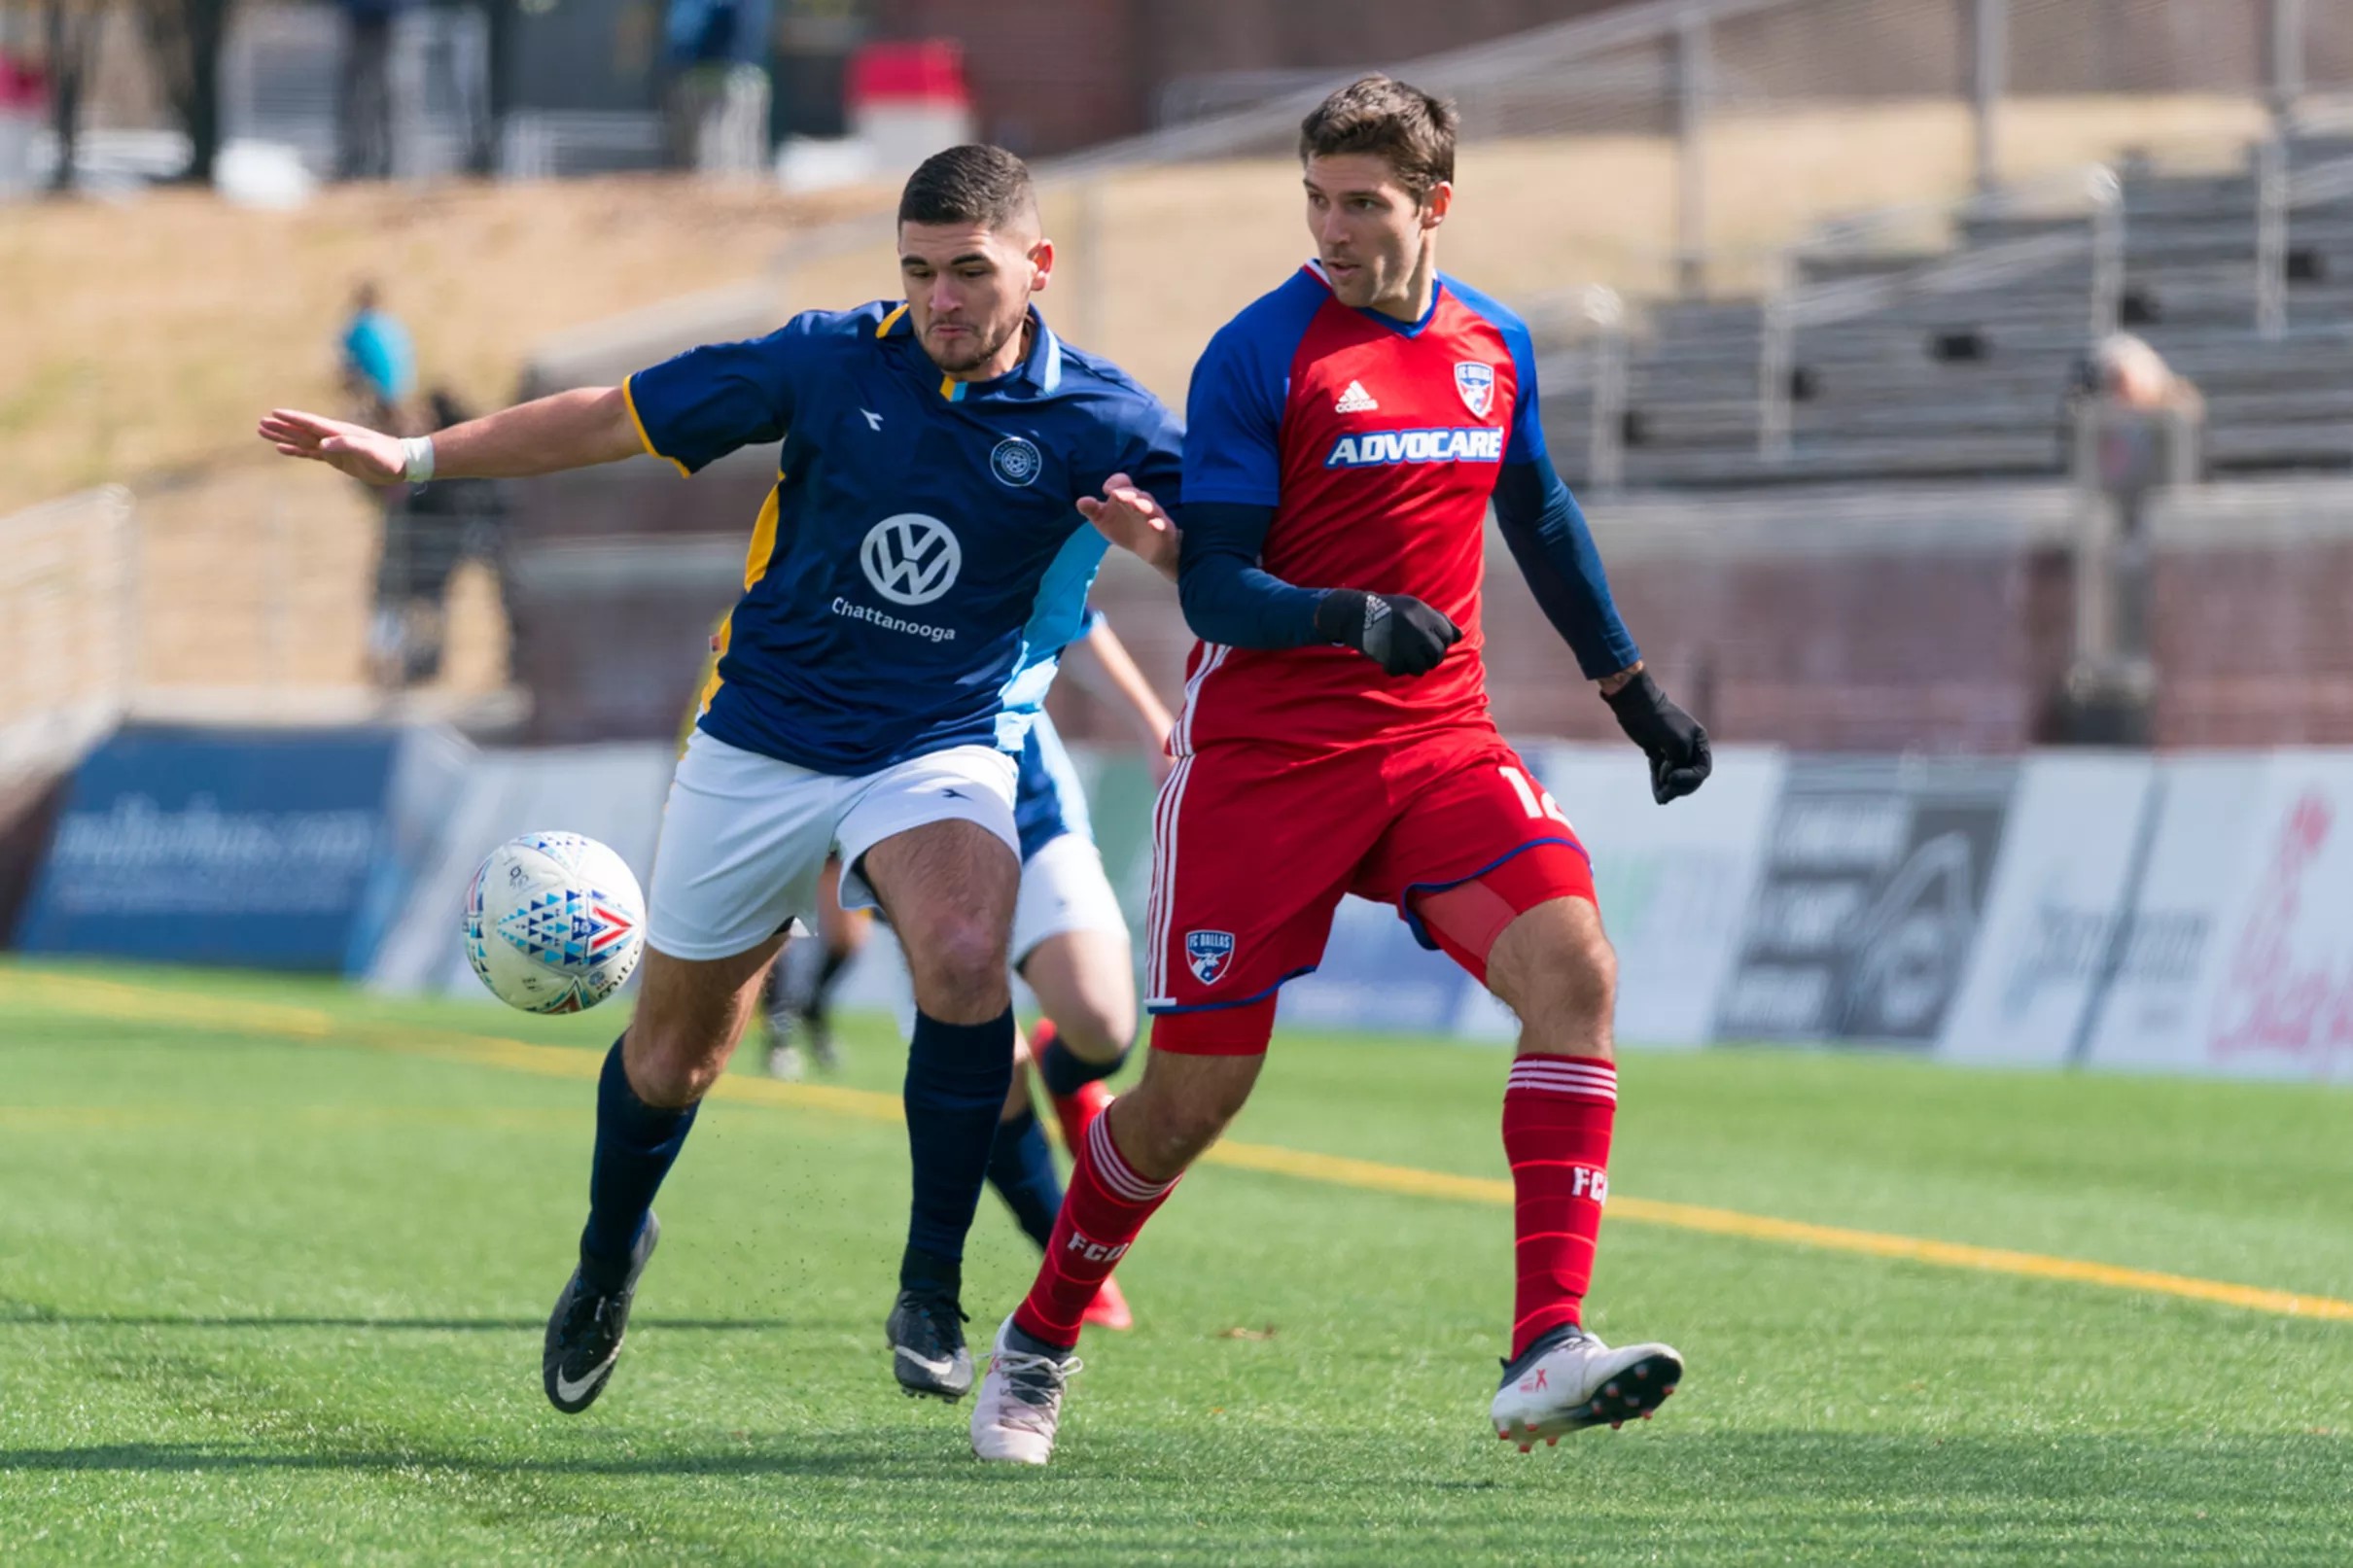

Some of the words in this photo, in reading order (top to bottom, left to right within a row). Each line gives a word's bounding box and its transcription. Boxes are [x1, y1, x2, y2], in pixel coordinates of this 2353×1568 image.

[1326, 428, 1503, 466] ADVOCARE
[831, 596, 957, 643] Chattanooga
[1189, 934, 1199, 948] FC
[1200, 933, 1231, 949] DALLAS
